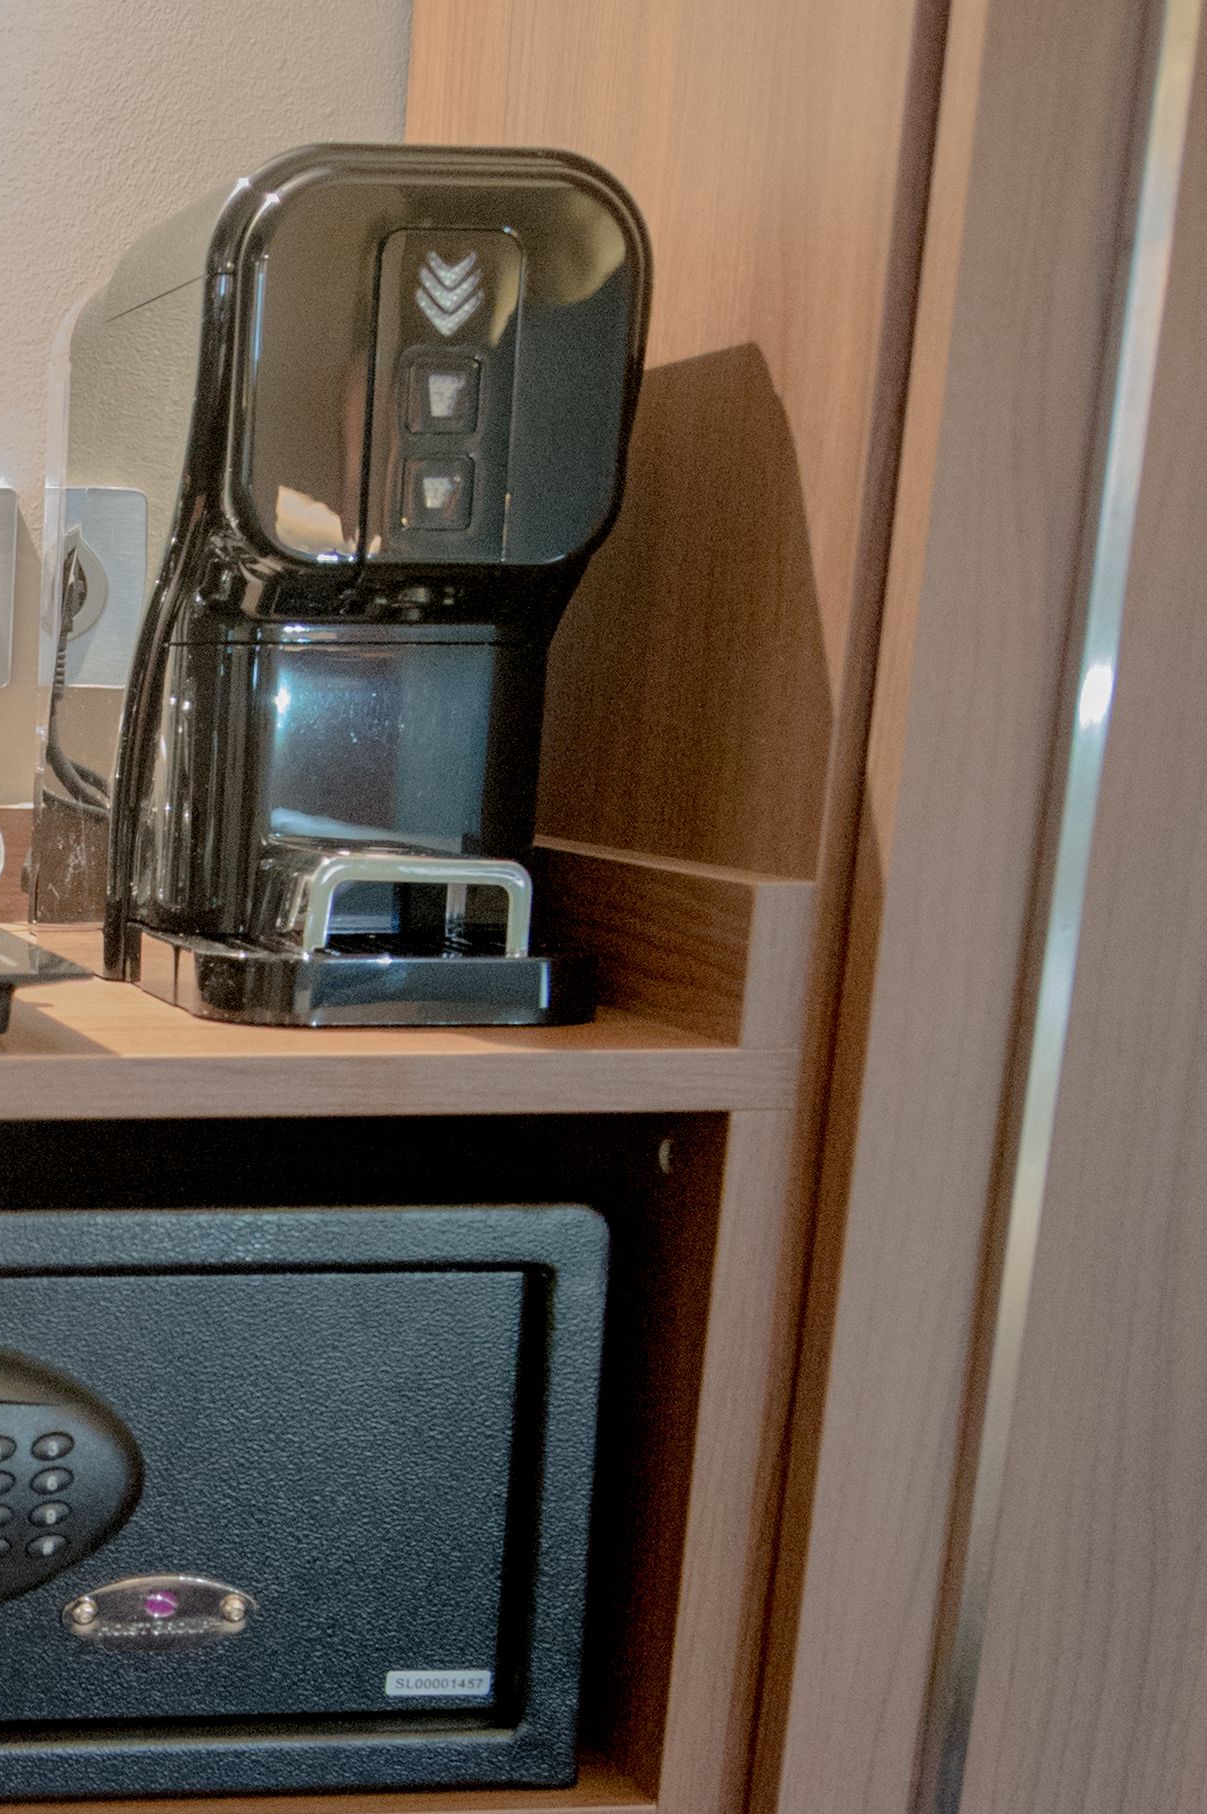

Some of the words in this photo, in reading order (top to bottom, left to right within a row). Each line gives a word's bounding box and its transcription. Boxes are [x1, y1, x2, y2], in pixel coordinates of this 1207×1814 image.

[47, 1440, 58, 1456] 3
[47, 1476, 58, 1491] 6
[45, 1510, 56, 1525] 9
[395, 1678, 483, 1690] SL00001457
